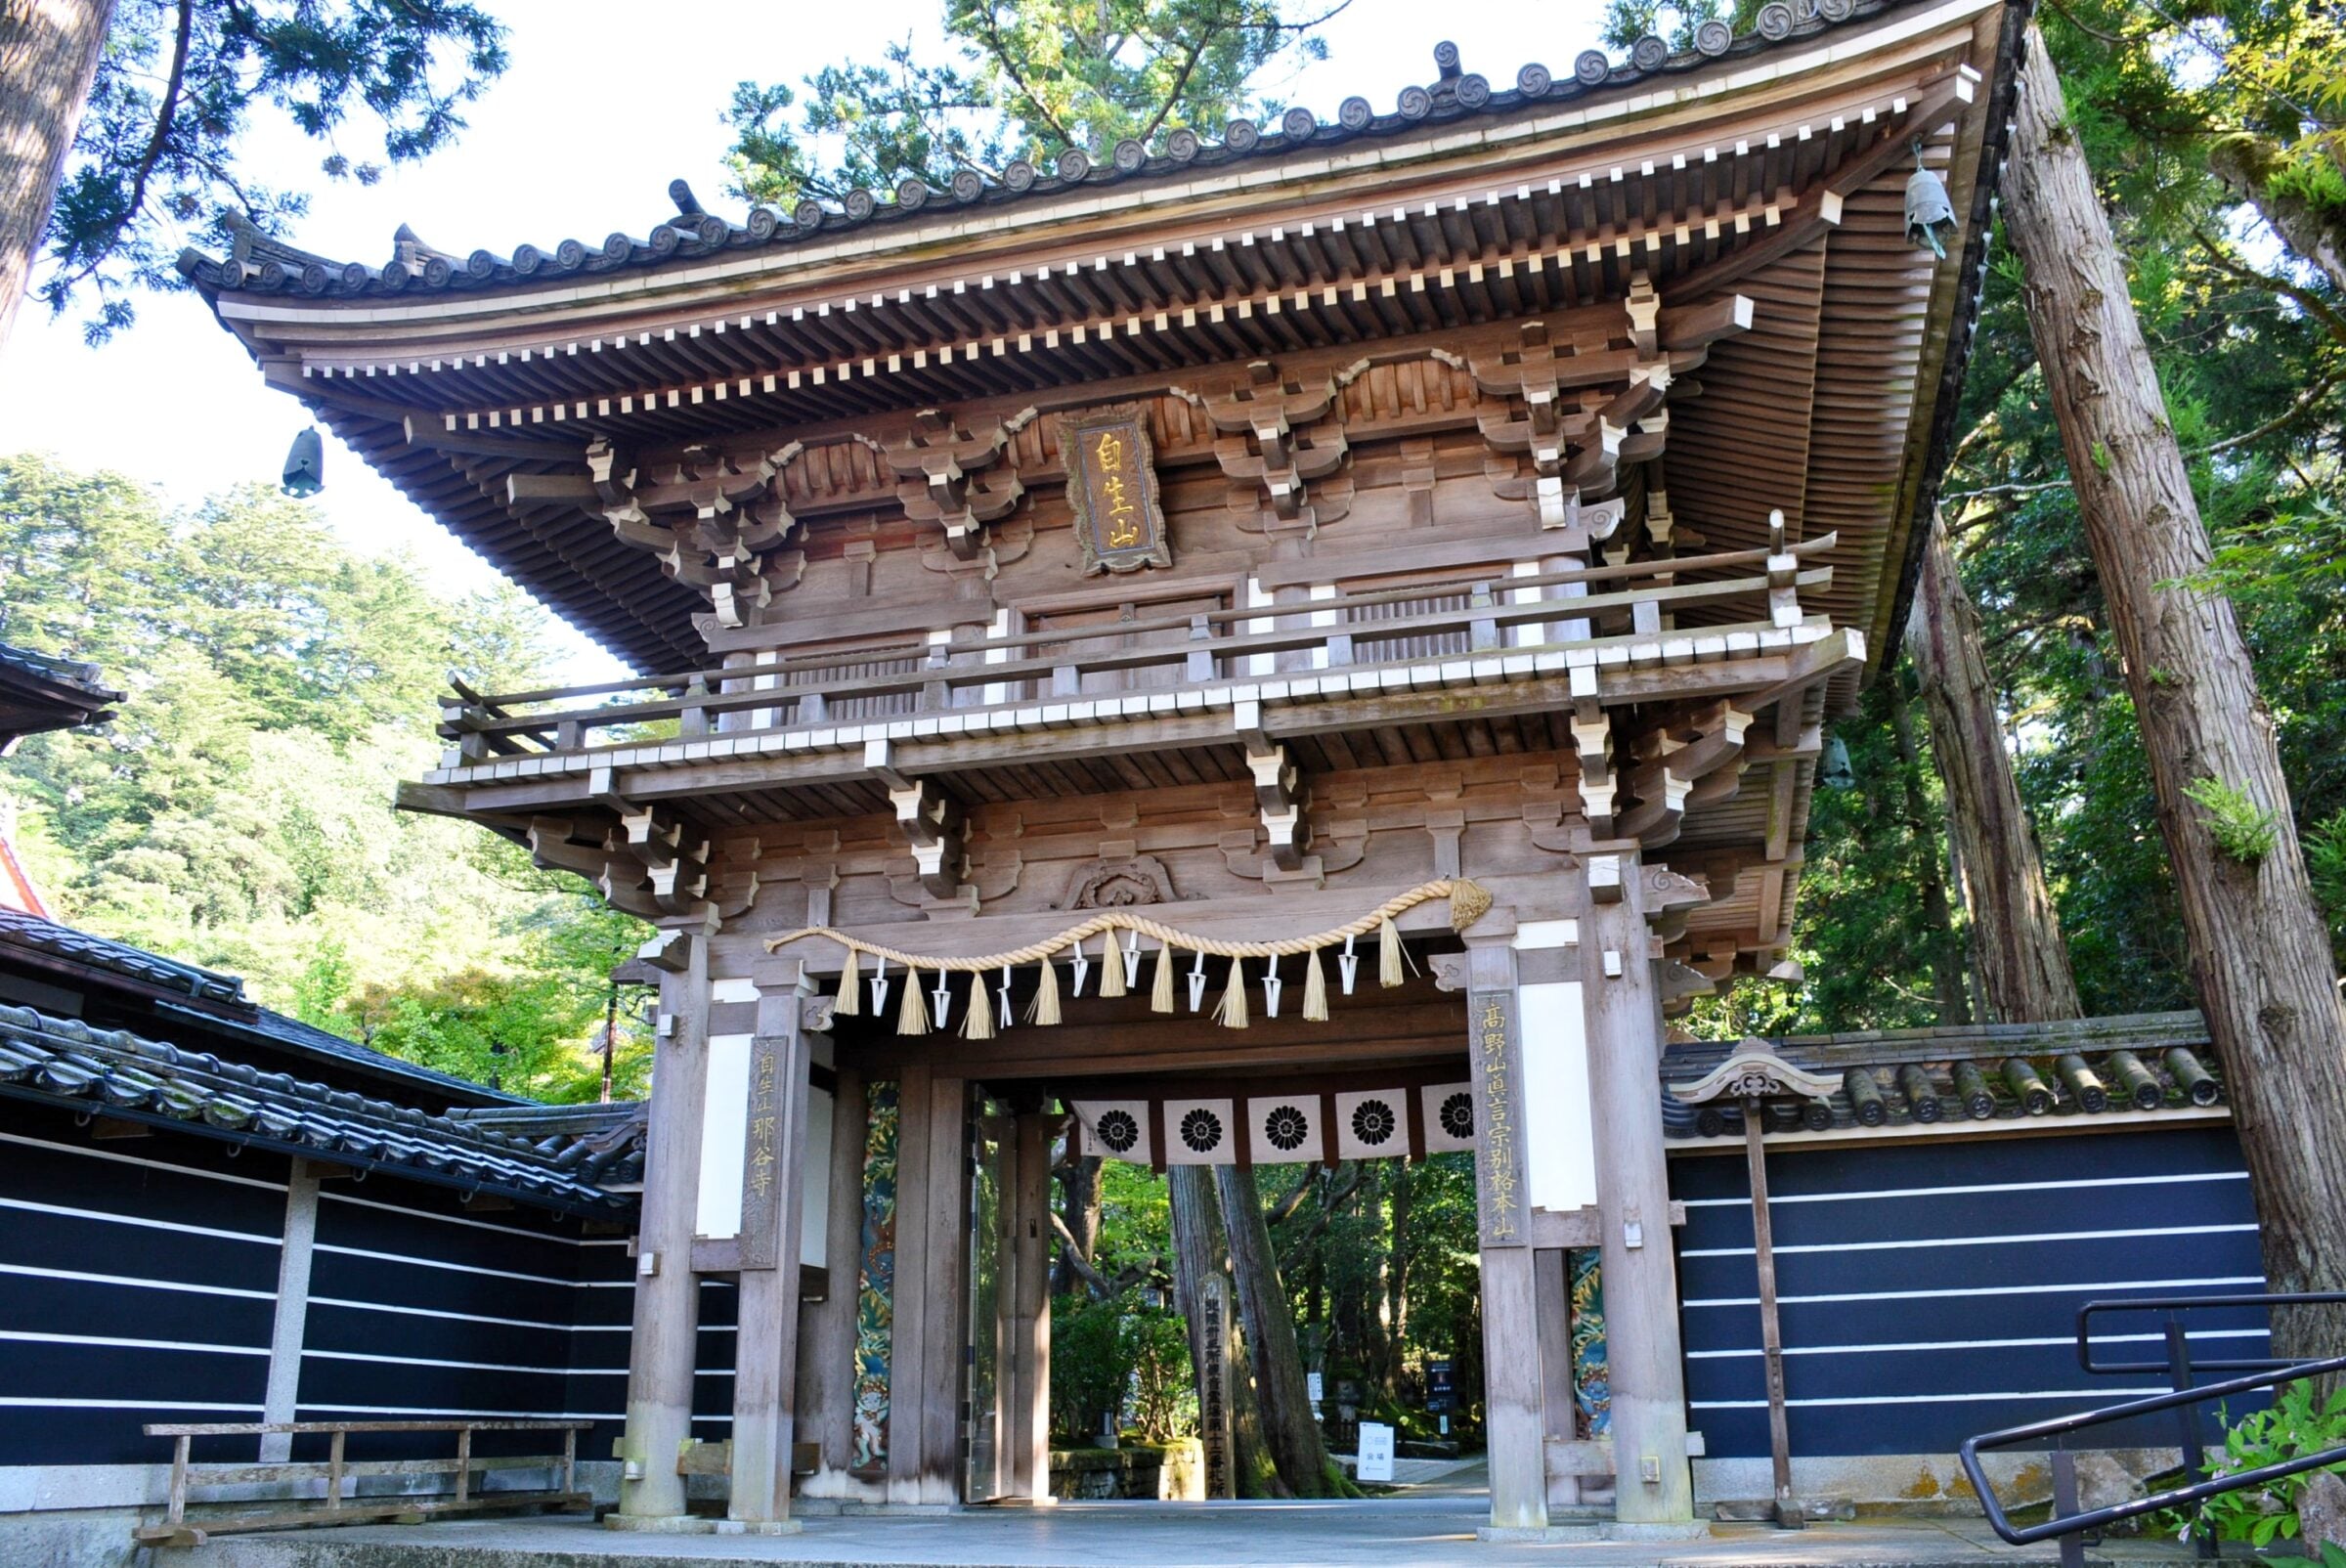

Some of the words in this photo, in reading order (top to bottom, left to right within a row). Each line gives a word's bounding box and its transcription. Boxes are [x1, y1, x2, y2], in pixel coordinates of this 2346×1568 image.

[1096, 433, 1139, 548] 自生山
[751, 1051, 775, 1198] 自生山那谷寺
